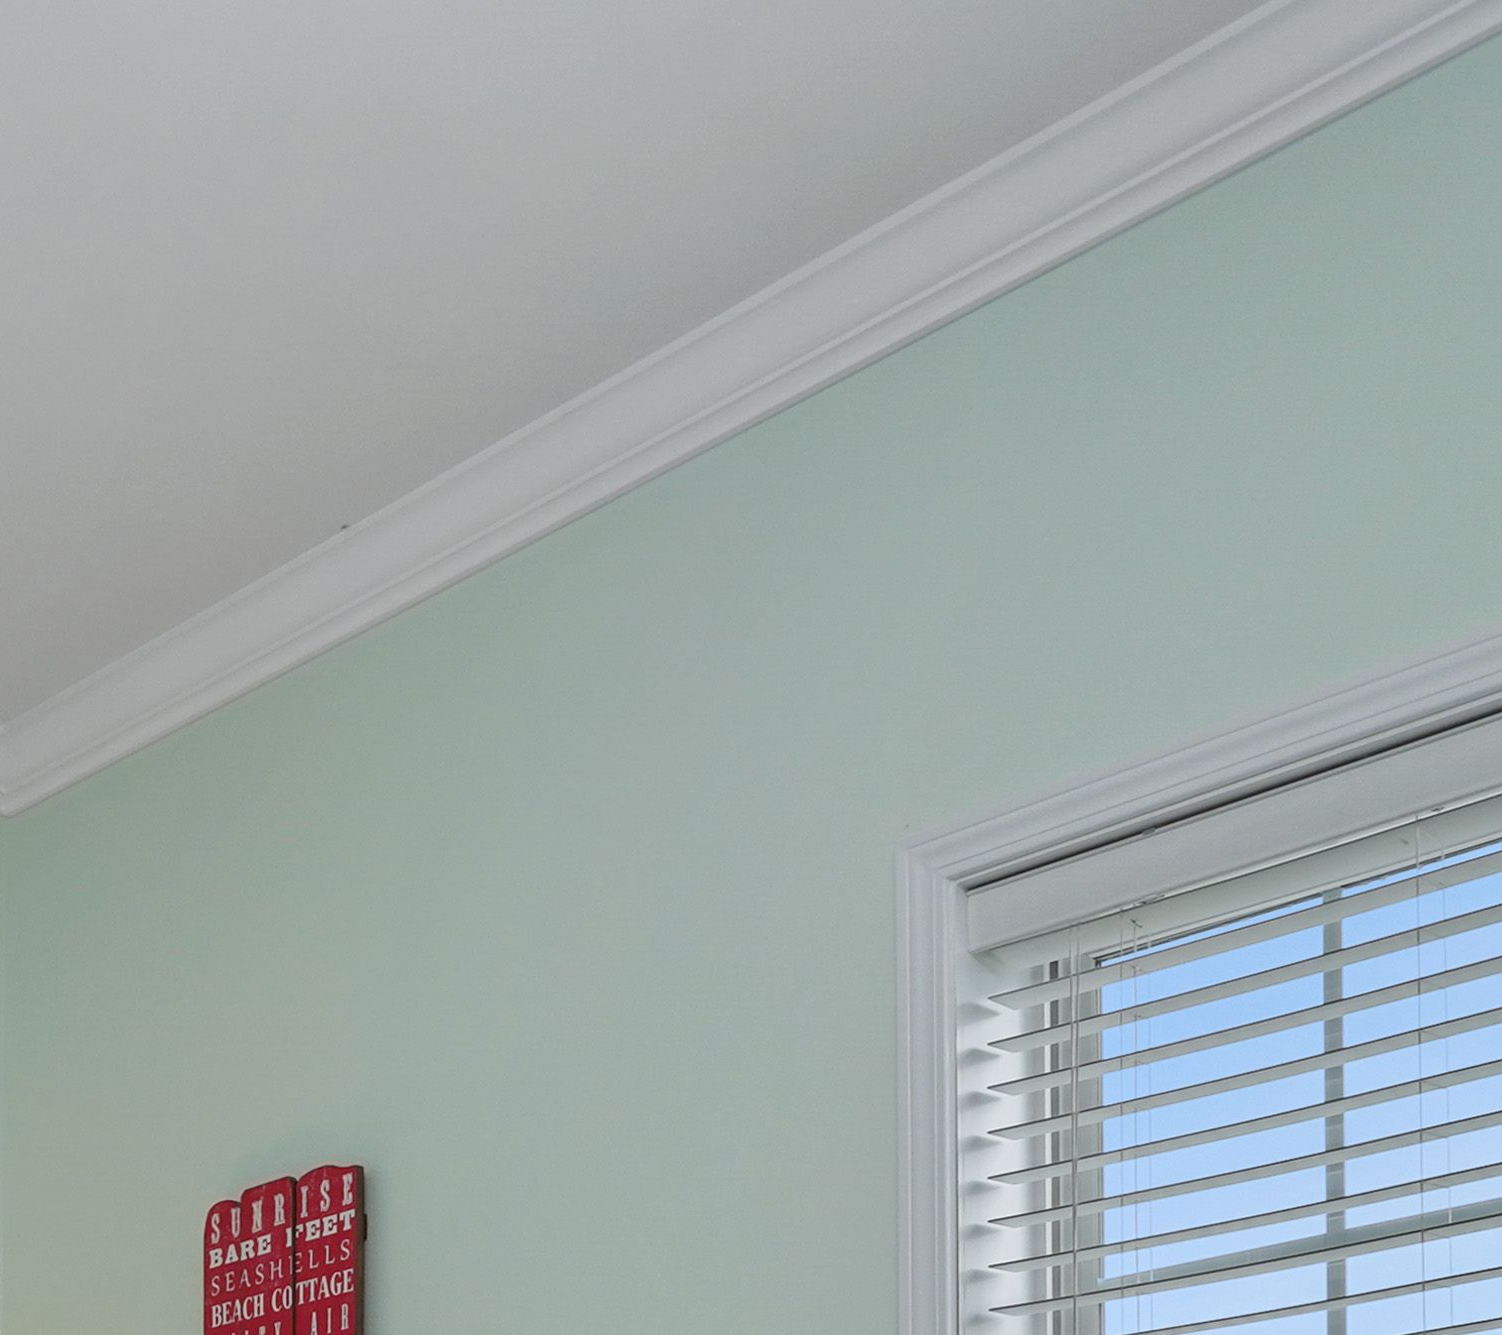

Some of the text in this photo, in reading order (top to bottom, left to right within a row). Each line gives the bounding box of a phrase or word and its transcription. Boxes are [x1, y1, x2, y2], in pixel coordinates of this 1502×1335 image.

[210, 1172, 354, 1245] SUNRISE
[209, 1209, 355, 1269] BARE FEET
[210, 1238, 351, 1297] SEASHELLS
[211, 1268, 355, 1328] BEACH COTTAGE
